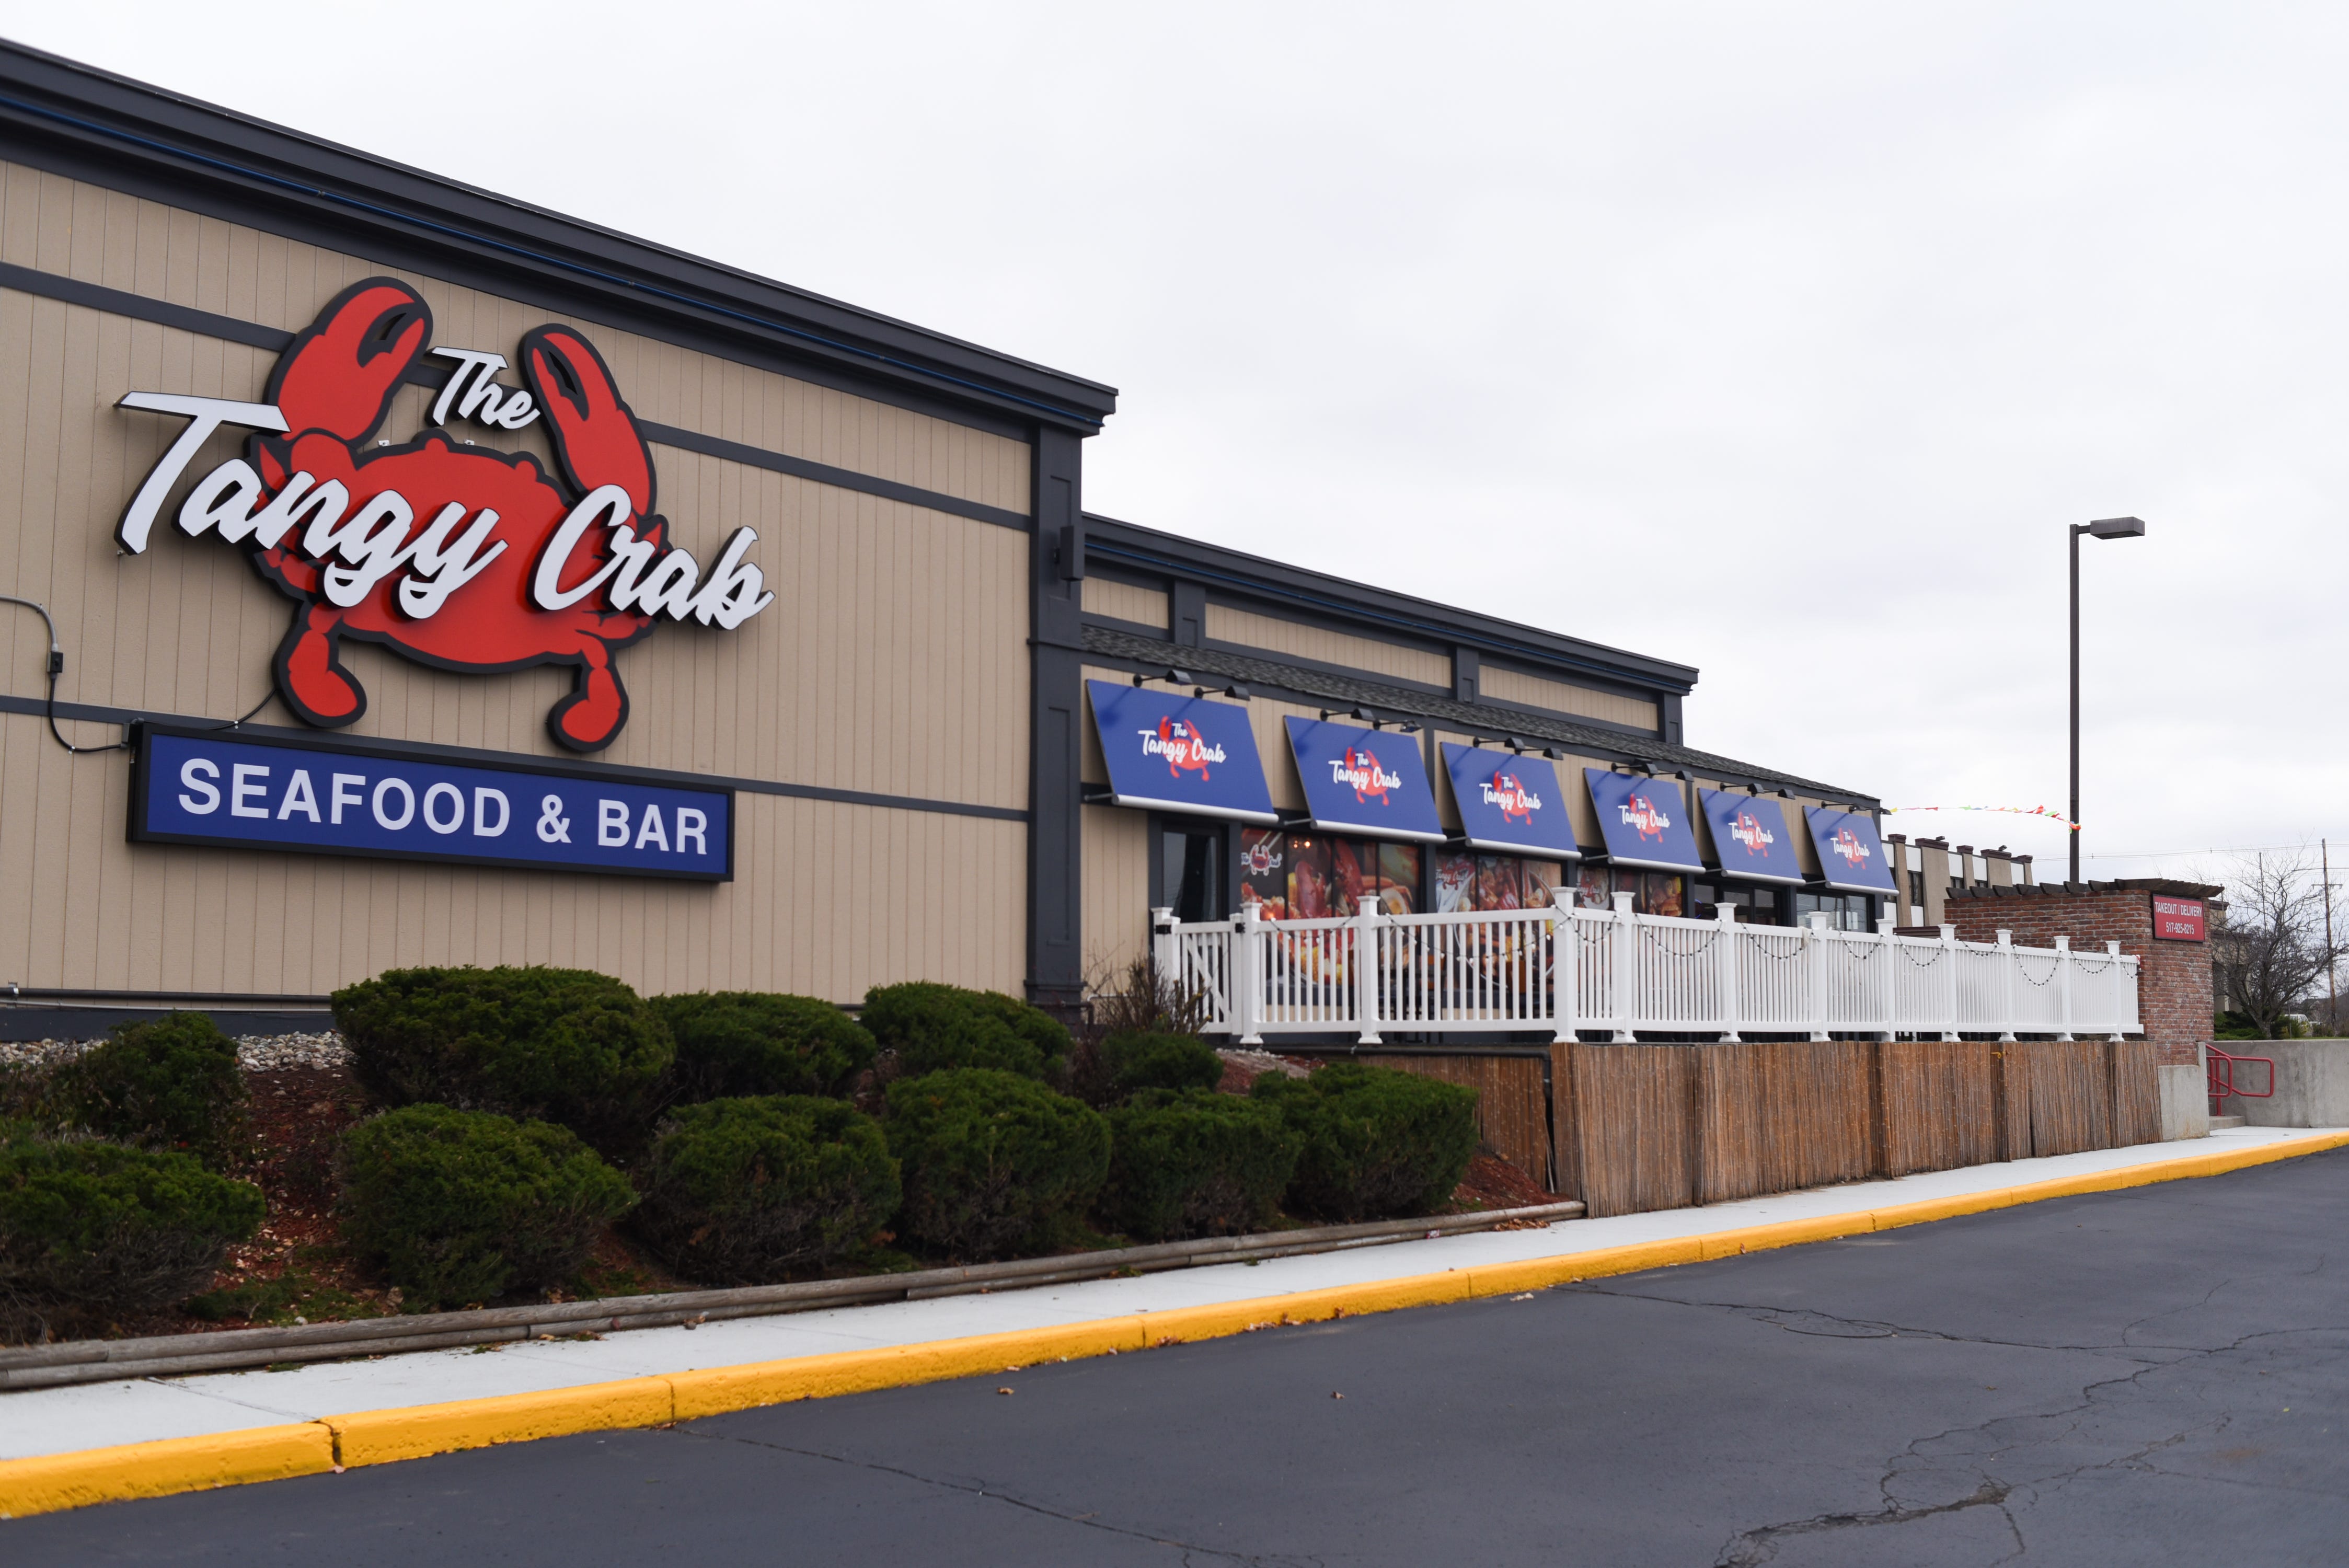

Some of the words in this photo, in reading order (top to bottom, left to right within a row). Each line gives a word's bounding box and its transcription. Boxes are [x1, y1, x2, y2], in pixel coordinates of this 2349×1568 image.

[425, 345, 541, 429] The
[113, 390, 509, 619] Tangy
[534, 484, 776, 630] Crab
[1171, 723, 1188, 737] The
[1137, 730, 1188, 763] Tangy
[1191, 737, 1226, 763] Crab
[1355, 753, 1369, 766] The
[1328, 760, 1369, 790] Tangy
[1373, 766, 1401, 789] Crab
[1501, 777, 1514, 788] The
[178, 758, 511, 838] SEAFOOD
[535, 794, 572, 844] &
[596, 799, 708, 856] BAR
[1479, 783, 1515, 811] Tangy
[1517, 789, 1542, 810] Crab
[1636, 799, 1646, 809] The
[1617, 805, 1648, 830] Tangy
[1650, 809, 1670, 828] Crab
[1728, 822, 1755, 845] Tangy
[1756, 826, 1774, 844] Crab
[1830, 837, 1853, 859] Tangy
[1854, 841, 1870, 857] Crab
[2155, 902, 2177, 915] TAKEOUT
[2181, 905, 2202, 917] DELIVERY
[2166, 922, 2194, 935] 517-925-8215
